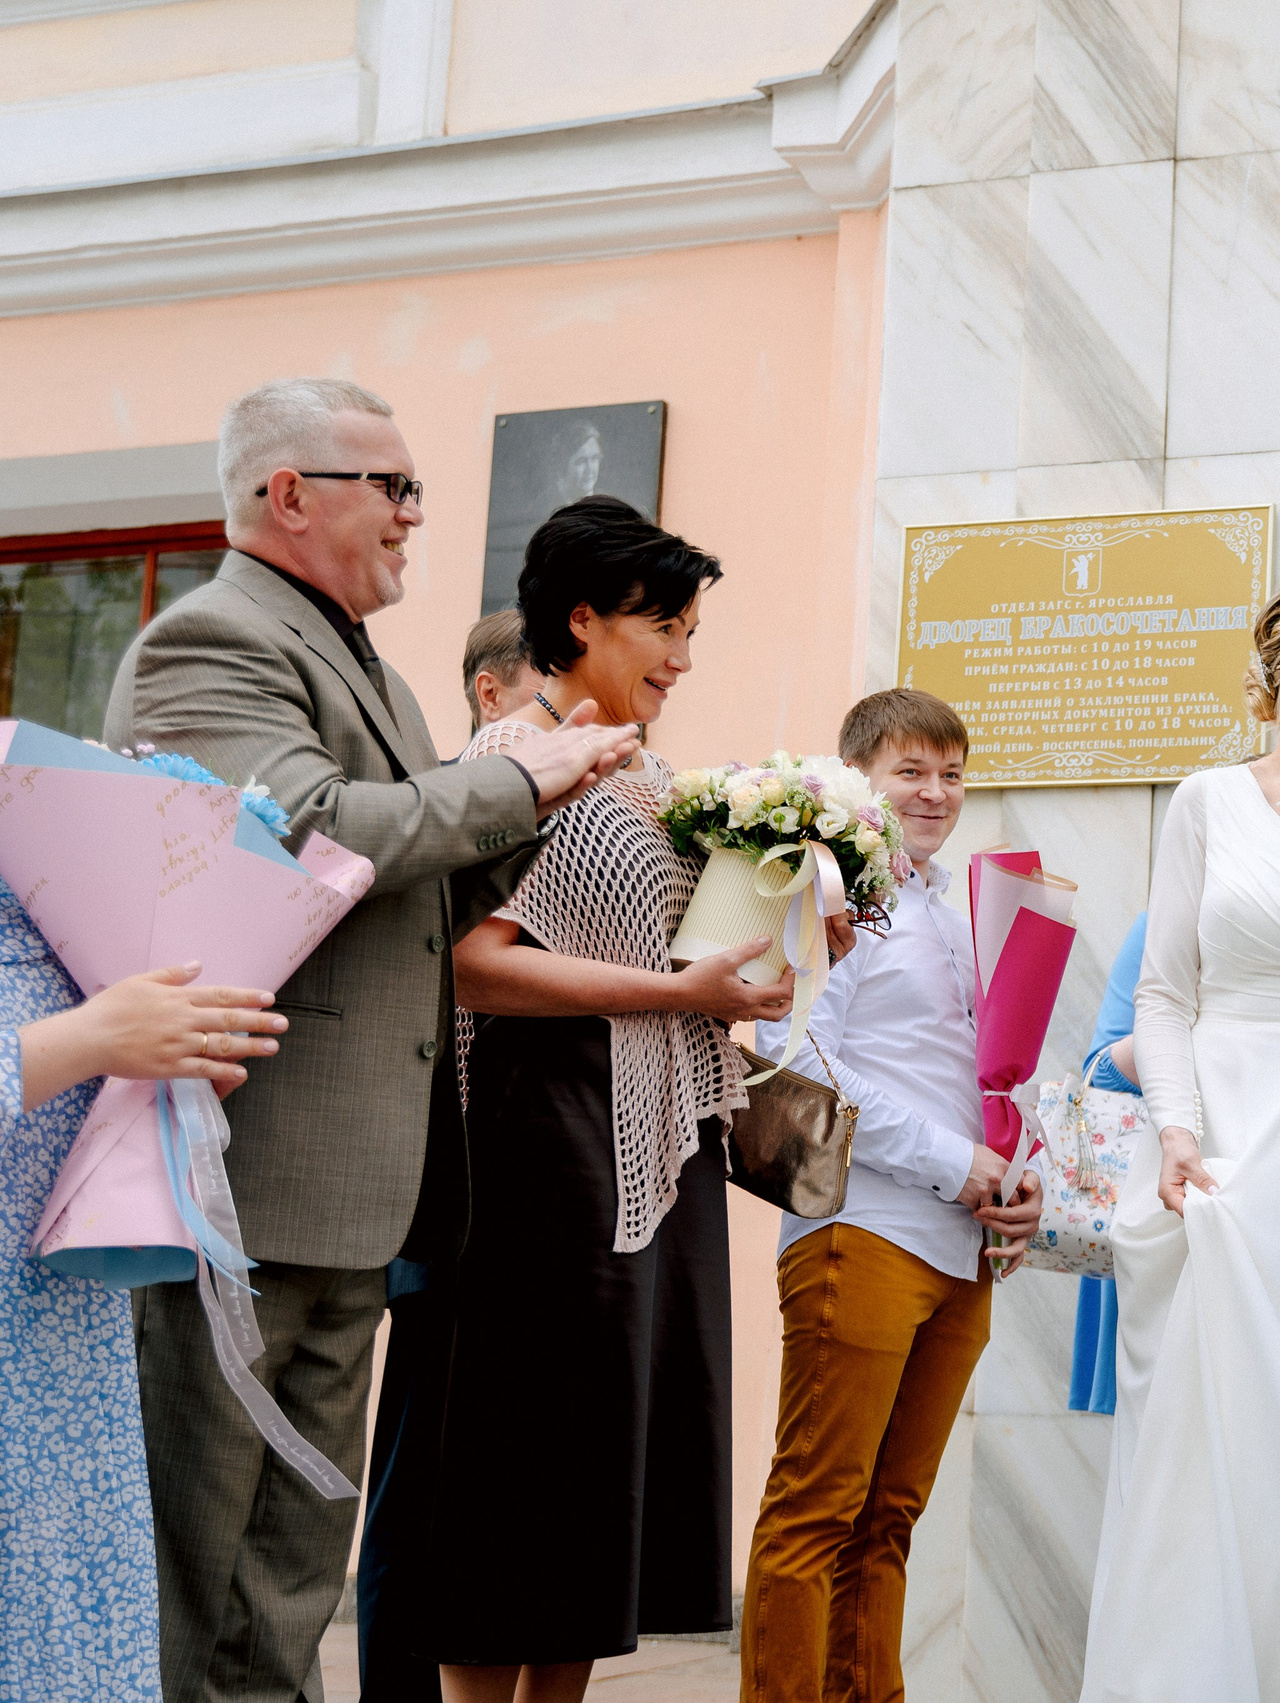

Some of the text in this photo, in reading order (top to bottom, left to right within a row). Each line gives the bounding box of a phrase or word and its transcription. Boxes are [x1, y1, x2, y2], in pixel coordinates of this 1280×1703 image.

[991, 601, 1035, 614] ОТДЕЛ
[1038, 600, 1072, 611] ЗАГС
[1089, 595, 1174, 609] ЯРОСЛАВЛЯ
[917, 606, 1248, 650] ДВОРЕЦ БРАКОСОЧЕТАНИЯ
[964, 647, 1013, 659] РЕЖИМ
[1017, 644, 1077, 657] РАБОТЫ:
[1092, 641, 1110, 653] 10
[1134, 639, 1152, 651] 19
[1155, 639, 1198, 650] ЧАСОВ
[964, 663, 1009, 676] ПРИЁМ
[1012, 661, 1078, 674] ГРАЖДАН:
[1092, 658, 1110, 671] 10
[1133, 656, 1152, 669] 18
[1154, 657, 1196, 668] ЧАСОВ
[988, 680, 1050, 693] ПЕРЕРЫВ
[1063, 677, 1082, 690] 13
[1106, 675, 1125, 688] 14
[1128, 676, 1169, 687] ЧАСОВ
[948, 700, 981, 711] РИЁМ
[986, 697, 1062, 710] ЗАЯВЛЕНИЙ
[1079, 694, 1169, 707] ЗАКЛЮЧЕНИИ
[1173, 692, 1220, 703] БРАКА,
[981, 710, 1060, 723] ПОВТОРНЫХ
[1063, 707, 1152, 721] ДОКУМЕНТОВ
[1156, 706, 1172, 716] ИЗ
[1177, 704, 1233, 715] АРХИВА:
[992, 725, 1037, 737] СРЕДА,
[1041, 722, 1097, 734] ЧЕТВЕРГ
[1115, 718, 1134, 731] 10
[1161, 717, 1181, 729] 18
[1188, 718, 1231, 728] ЧАСОВ
[968, 742, 1001, 755] ДНОЙ
[1002, 742, 1034, 754] ДЕНЬ
[1042, 739, 1126, 751] ВОСКРЕСЕНЬЕ,
[1129, 736, 1217, 749] ПОНЕДЕЛЬНИК
